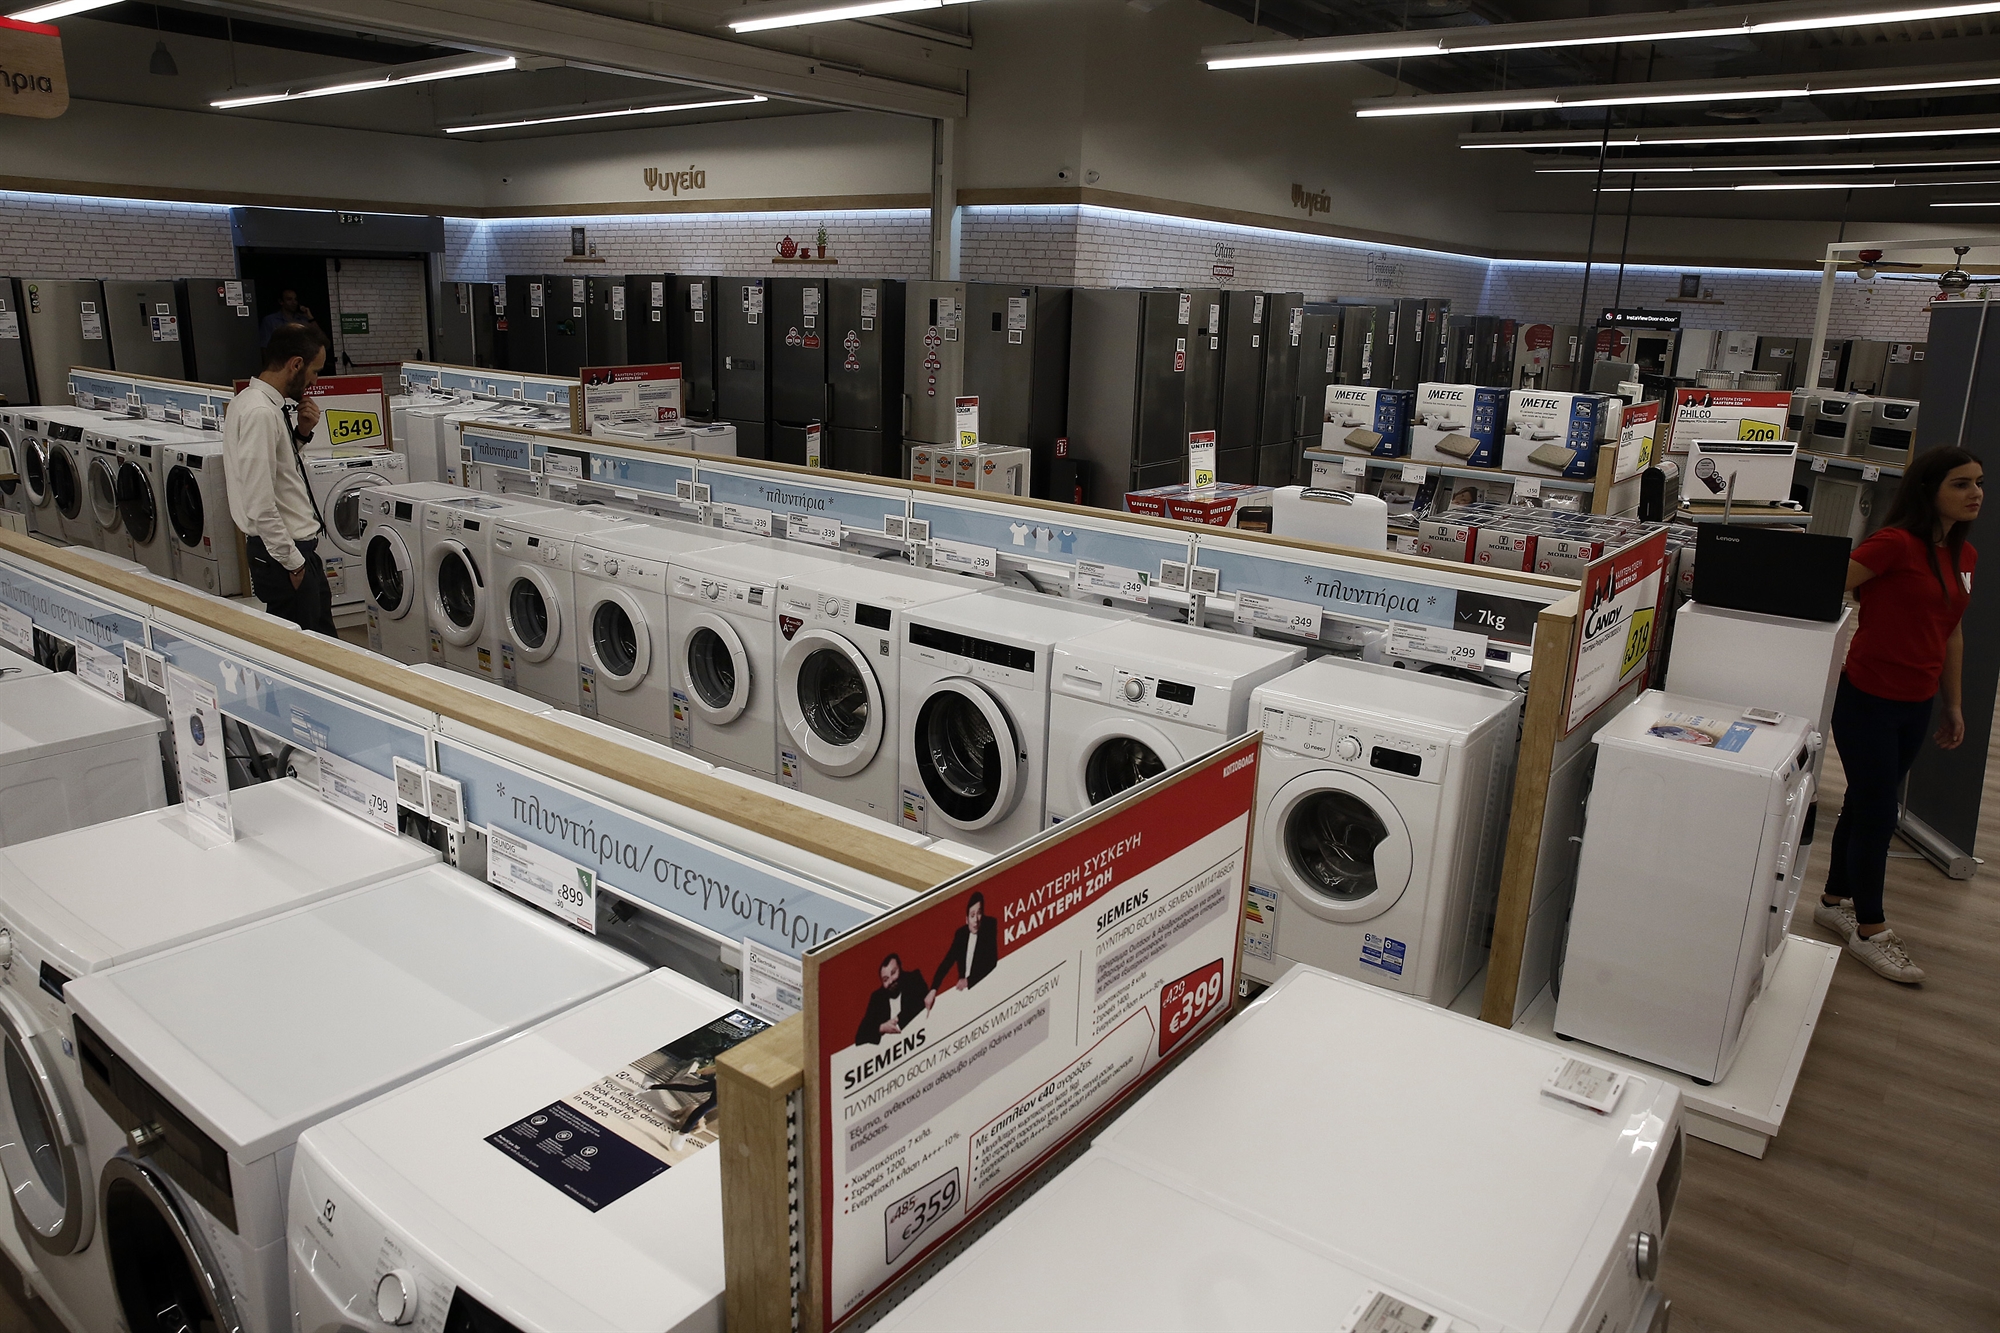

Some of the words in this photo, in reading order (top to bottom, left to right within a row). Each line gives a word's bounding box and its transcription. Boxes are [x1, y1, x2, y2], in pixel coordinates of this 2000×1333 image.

[643, 165, 706, 196] Ψυγεία
[1291, 183, 1332, 217] Ψυγεία
[1335, 390, 1367, 400] IMETEC
[1428, 390, 1463, 400] IMETEC
[1521, 398, 1559, 409] IMETEC
[661, 411, 676, 419] €449
[1680, 409, 1711, 418] PHILCO
[333, 419, 373, 437] €549
[479, 444, 518, 461] πλυντήρια
[766, 490, 826, 511] πλυντήρια
[1131, 501, 1158, 509] UNITED
[1210, 506, 1231, 514] UNITED
[754, 518, 767, 528] €339
[822, 529, 836, 538] €339
[1715, 534, 1740, 544] Lenovo
[974, 558, 990, 567] €339
[1547, 551, 1577, 559] MORRIS
[1123, 582, 1142, 593] €349
[1316, 580, 1420, 613] πλυντήρια
[1290, 615, 1312, 627] €349
[1477, 609, 1506, 631] 7kg
[1451, 646, 1476, 658] €299
[1624, 621, 1650, 664] €319
[369, 794, 388, 813] €799
[491, 837, 515, 853] GRUNDIG
[1004, 866, 1080, 922] ΚΑΛΥΤΕΡΗ
[1084, 832, 1141, 877] ΣΥΣΚΕΥΗ
[558, 884, 584, 906] €899
[1004, 886, 1082, 946] ΚΑΛΥΤΕΡΗ
[1086, 867, 1112, 897] ΖΩΗ
[1097, 889, 1148, 933] SIEMENS
[1095, 921, 1135, 957] ΠΛΥΝΤΗΡΙΟ
[1167, 885, 1193, 911] SIEMENS
[1364, 933, 1371, 941] 6
[1384, 939, 1392, 949] 6
[1169, 972, 1221, 1033] €399
[844, 1029, 926, 1090] SIEMENS
[845, 1072, 904, 1121] ΠΛΥΝΤΗΡΙΟ
[907, 1051, 936, 1082] 60CM
[939, 1043, 951, 1062] 7K
[953, 1019, 989, 1053] SIEMENS
[991, 981, 1049, 1029] WM12N267GR
[884, 1087, 920, 1120] ανθεκτικό
[922, 1080, 934, 1095] και
[935, 1057, 967, 1088] αθόρυβο
[968, 1043, 987, 1066] μοτέρ
[988, 1026, 1012, 1051] iQdrive
[1013, 1021, 1023, 1037] για
[581, 1089, 600, 1101] and
[597, 1098, 623, 1115] cared
[619, 1111, 634, 1121] for
[591, 1084, 611, 1096] look
[607, 1094, 641, 1114] washed,
[638, 1112, 663, 1127] dried
[600, 1080, 623, 1093] Your
[617, 1089, 656, 1113] effortless
[580, 1099, 598, 1110] one
[593, 1108, 611, 1119] go.
[976, 1131, 988, 1149] Με
[990, 1094, 1035, 1138] επιπλέον
[1037, 1080, 1055, 1104] €40
[851, 1142, 906, 1189] Χωρητικότητα
[908, 1138, 912, 1149] 7
[851, 1170, 883, 1202] Στροφές
[886, 1155, 906, 1176] 1200.
[851, 1175, 894, 1215] Ενεργειακή
[896, 1156, 920, 1182] κλάση
[902, 1180, 956, 1240] €359
